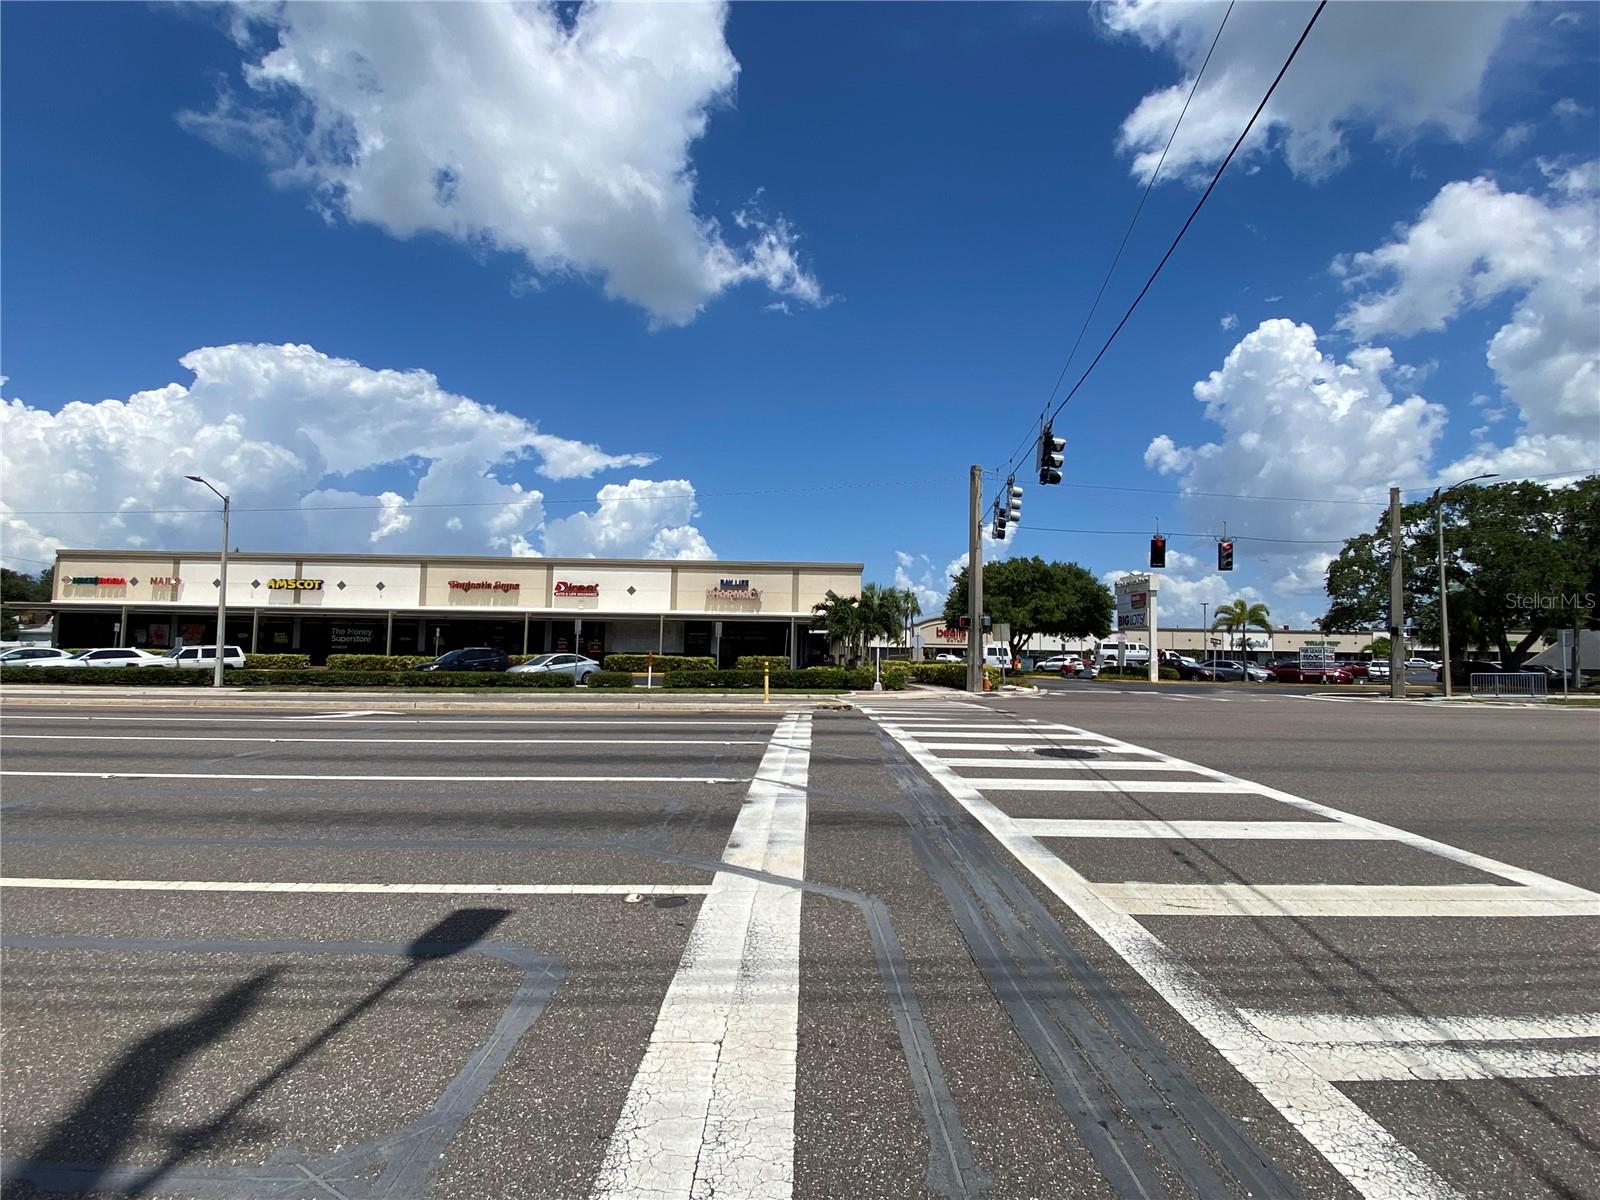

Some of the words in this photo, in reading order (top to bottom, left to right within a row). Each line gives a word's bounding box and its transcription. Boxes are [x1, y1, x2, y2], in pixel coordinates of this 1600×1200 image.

[150, 577, 182, 585] NAILS
[267, 579, 324, 590] AMSCOT
[705, 590, 763, 600] PHARMACY
[1119, 615, 1129, 627] BIG
[347, 628, 373, 637] Money
[331, 635, 371, 643] Superstore
